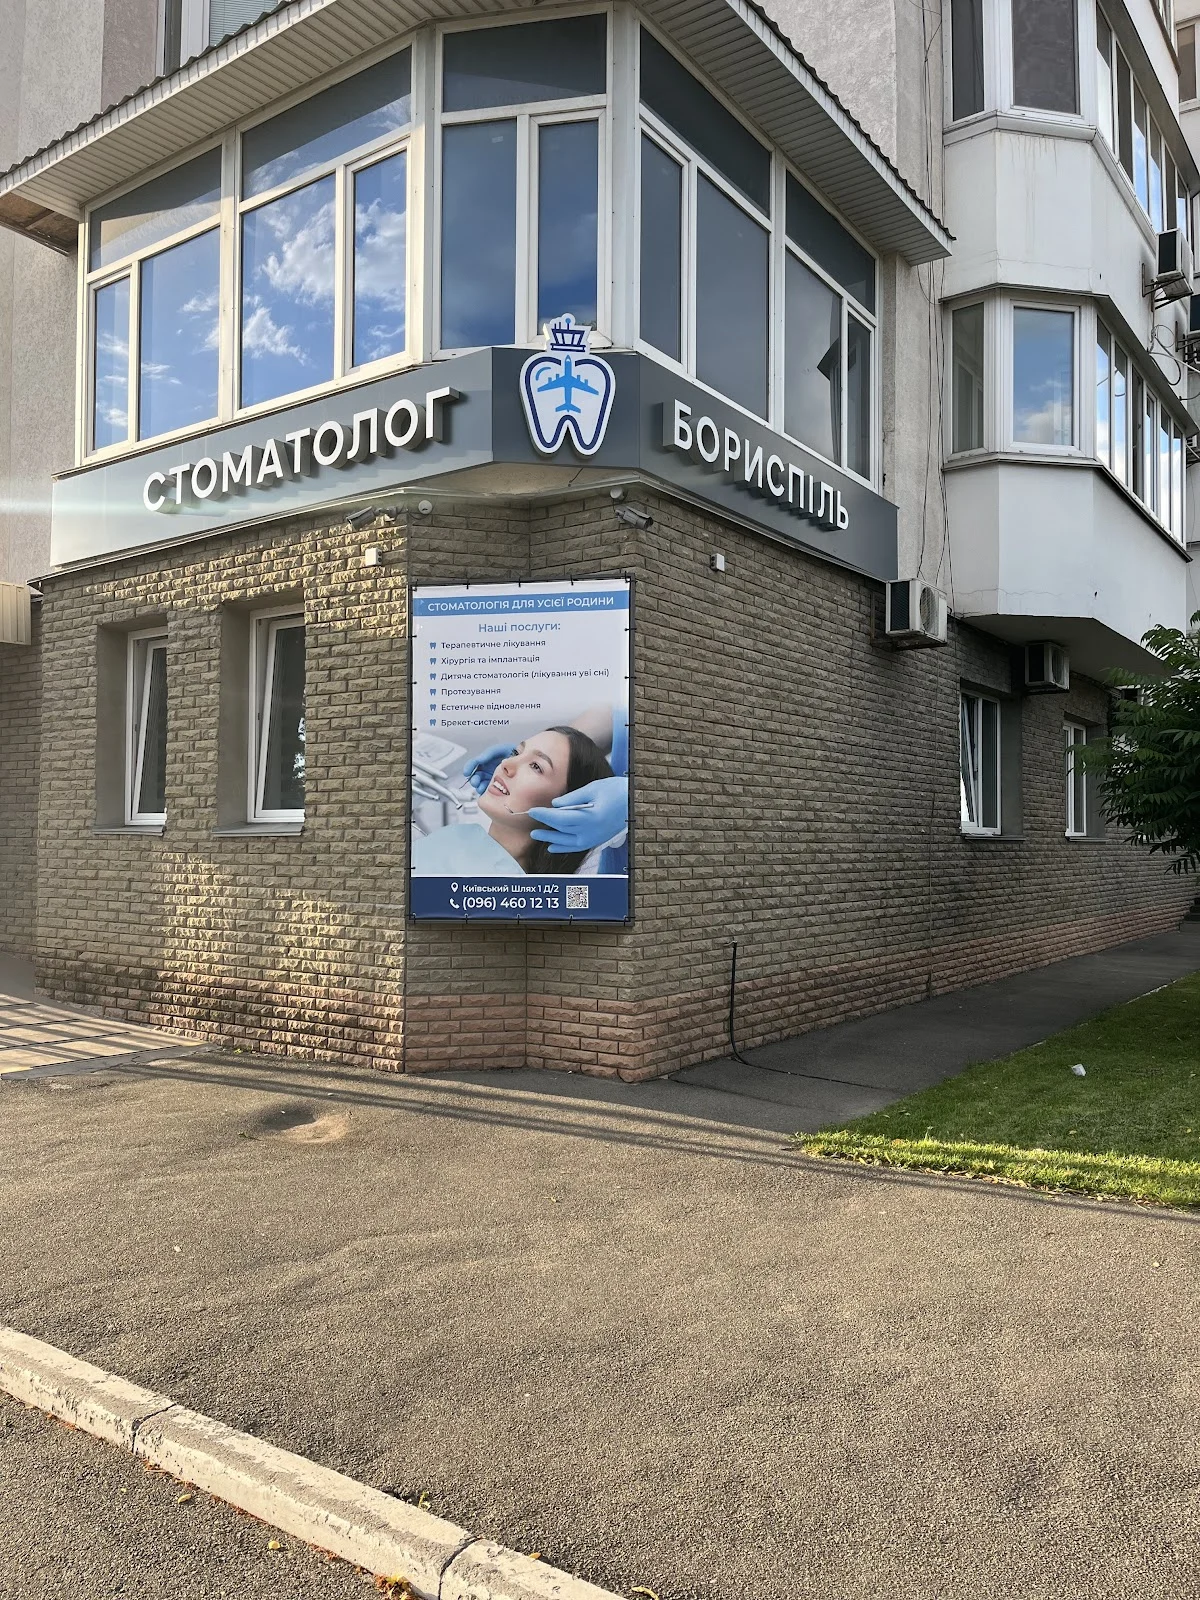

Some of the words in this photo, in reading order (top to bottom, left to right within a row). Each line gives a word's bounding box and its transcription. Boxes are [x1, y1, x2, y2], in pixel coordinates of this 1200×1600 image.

[143, 386, 460, 512] СТОМАТОЛОГ
[674, 399, 849, 530] БОРИСПІЛЬ
[428, 600, 509, 611] СТОМАТОЛОГІЯ
[512, 600, 534, 610] ДЛЯ
[538, 598, 565, 608] УСІЄЇ
[568, 597, 614, 607] РОДИНИ
[479, 623, 507, 632] Наші
[511, 622, 561, 633] послуги:
[441, 641, 501, 650] Терапевтичне
[503, 639, 546, 648] лікування
[441, 657, 475, 666] Хірургія
[488, 655, 540, 664] імплантація
[441, 672, 472, 681] Дитяча
[474, 671, 529, 679] стоматологія
[531, 670, 577, 678] (лікування
[579, 669, 592, 677] уві
[594, 668, 609, 677] сні)
[441, 688, 501, 696] Протезування
[441, 703, 484, 711] Естетичне
[486, 702, 541, 710] відновлення
[441, 719, 509, 727] Брекет-системи
[462, 884, 509, 893] Київський
[511, 885, 536, 893] Шлях
[543, 884, 559, 893] Д/2
[463, 897, 496, 910] (096)
[500, 898, 526, 908] 460
[530, 898, 543, 908] 12
[546, 898, 559, 908] 13
